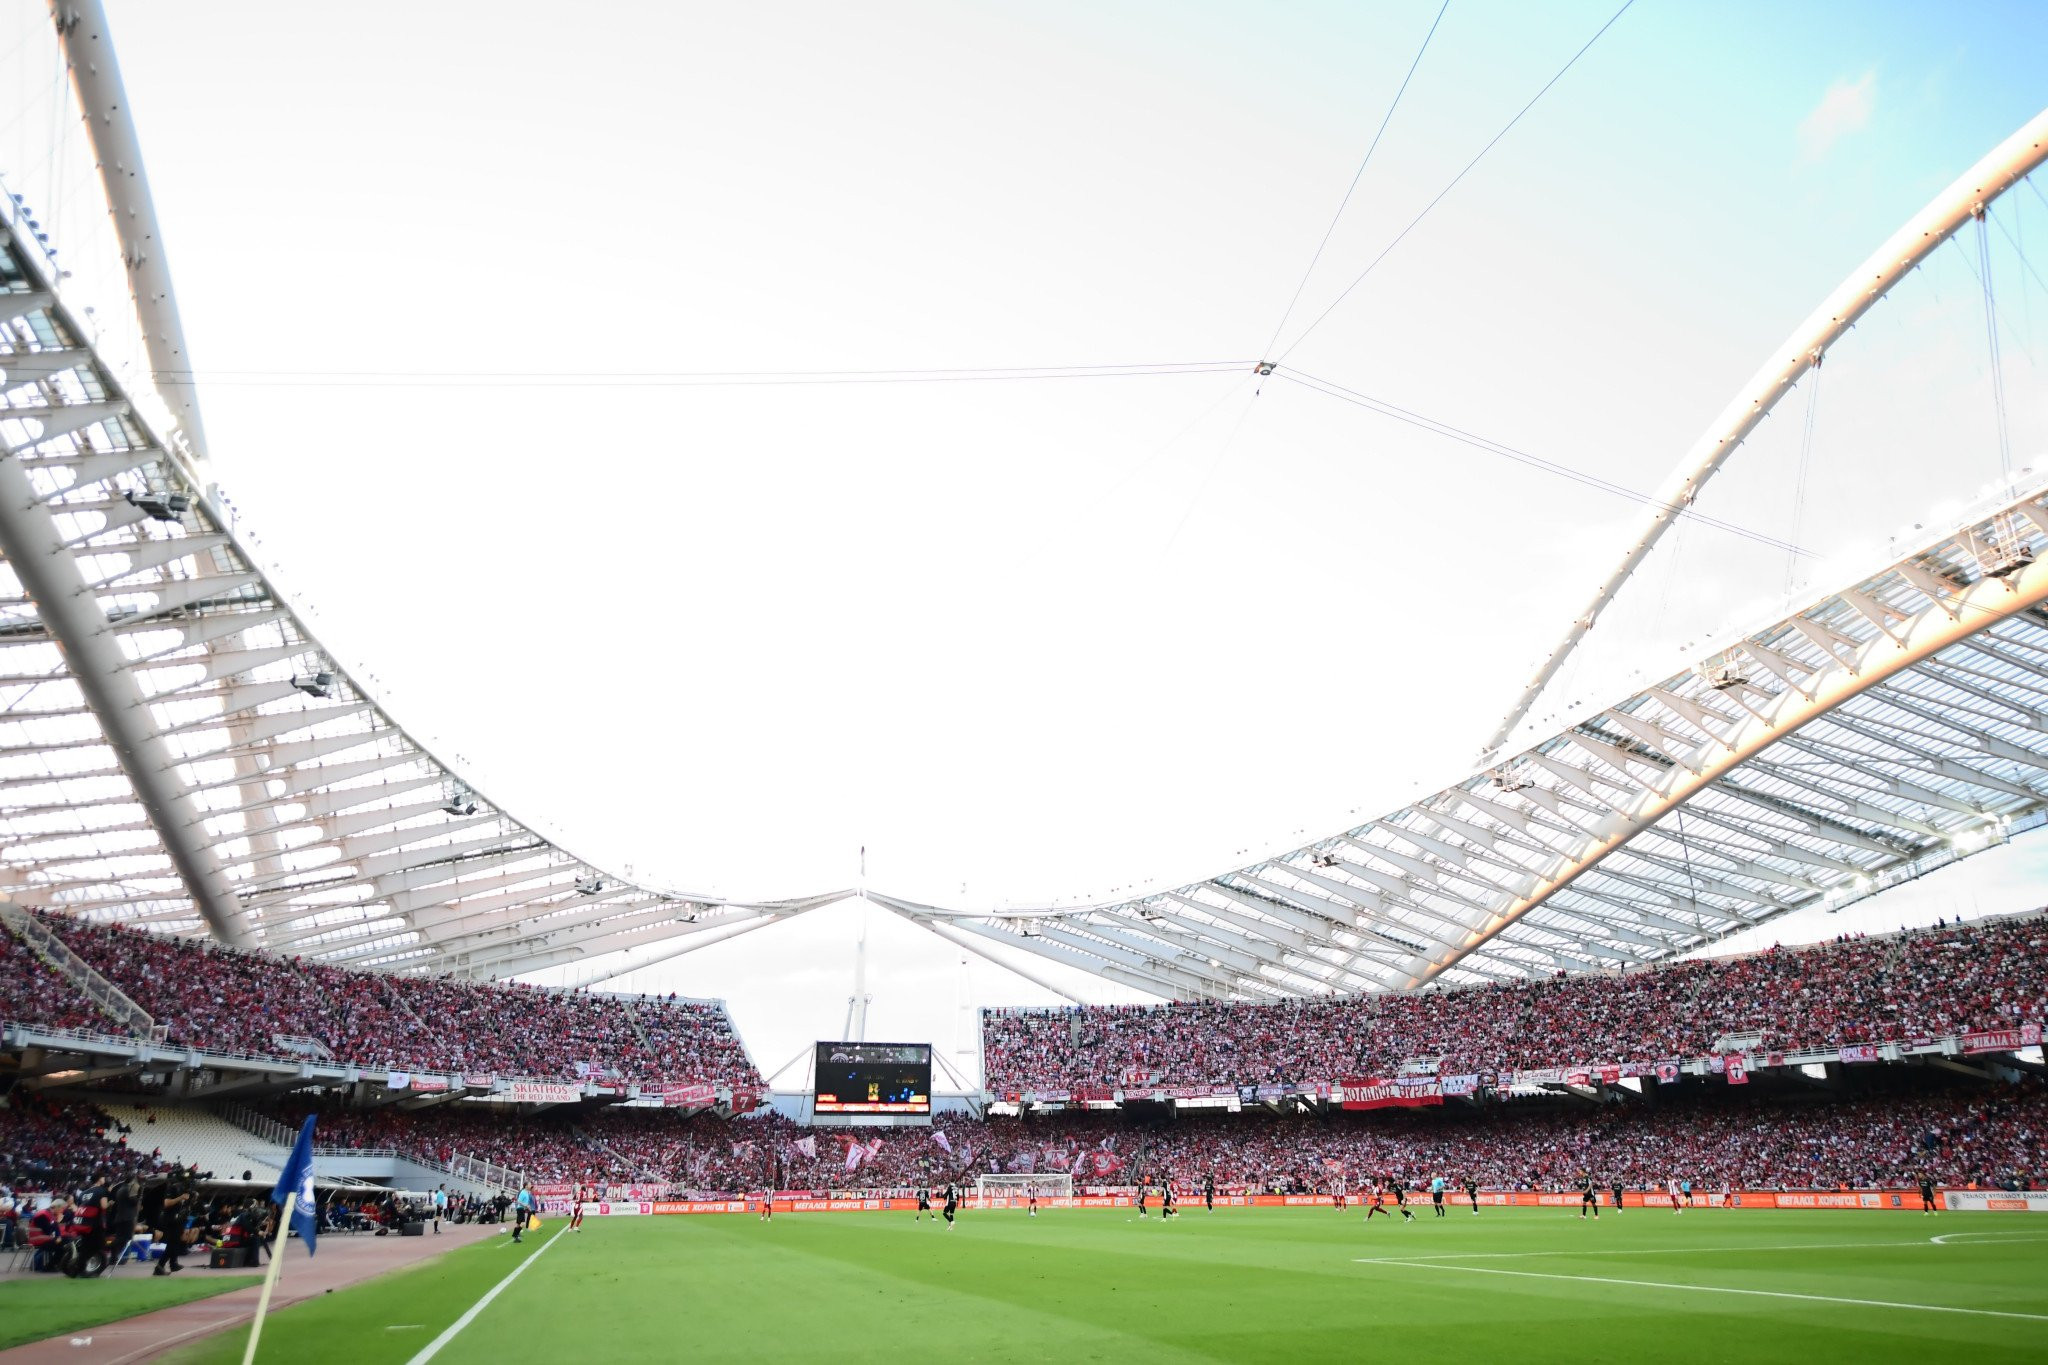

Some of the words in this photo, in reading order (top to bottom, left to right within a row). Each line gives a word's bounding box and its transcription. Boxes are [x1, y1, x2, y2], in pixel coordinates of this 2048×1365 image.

[514, 1084, 568, 1094] SKIATHOS
[740, 1096, 749, 1109] 7
[830, 1201, 861, 1209] ΧΟΡΗΓΟΣ
[1778, 1195, 1815, 1205] ΜΕΓΑΛΟΣ
[1818, 1195, 1857, 1206] ΧΟΡΗΓΟΣ
[655, 1204, 689, 1212] ΜΕΓΑΛΟΣ
[692, 1203, 726, 1211] ΧΟΡΗΓΟΣ
